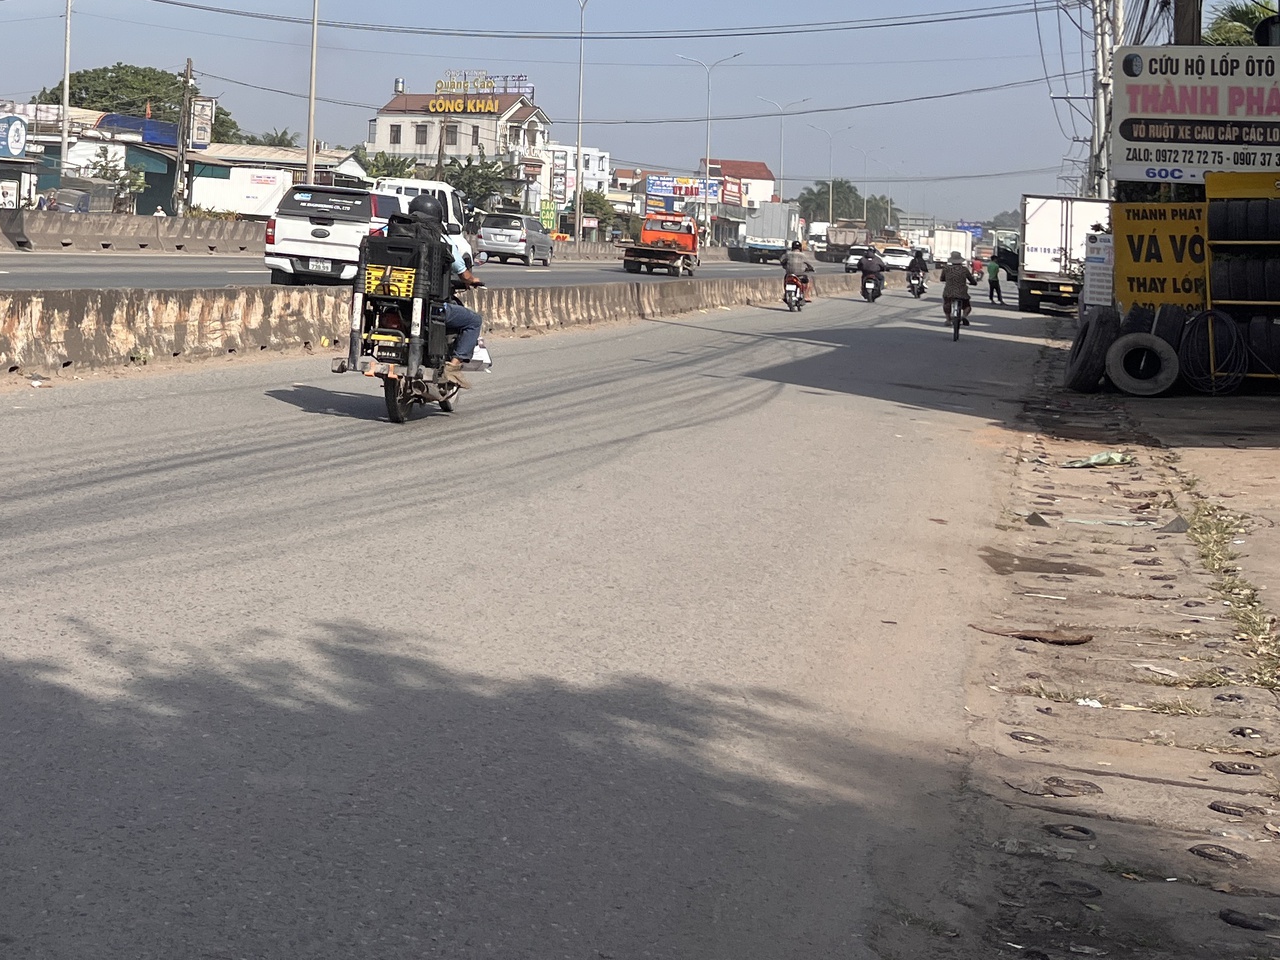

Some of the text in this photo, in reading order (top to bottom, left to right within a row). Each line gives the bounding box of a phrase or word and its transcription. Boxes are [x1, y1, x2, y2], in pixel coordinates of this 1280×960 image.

[1148, 52, 1275, 80] CỨU HỘ LỐP ÔTÔ
[428, 96, 464, 113] CÔNG
[1125, 78, 1219, 116] THÀNH
[1132, 121, 1146, 138] VỎ
[1148, 123, 1175, 142] RUỘT
[1178, 125, 1191, 140] XE
[1194, 126, 1215, 140] CAO
[1217, 122, 1240, 141] CẤP
[1242, 125, 1264, 142] CÁC
[1125, 148, 1153, 162] ZALO:
[1155, 149, 1179, 163] 0972
[1182, 150, 1194, 164] 72
[1197, 150, 1208, 164] 72
[1211, 151, 1223, 165] 75
[1233, 152, 1257, 166] 0907
[1260, 152, 1272, 166] 37
[1145, 168, 1184, 179] 60C
[541, 201, 555, 210] BAO
[541, 211, 555, 220] CAO
[542, 220, 553, 230] SU
[1126, 226, 1205, 263] VÁ VỎ
[1126, 276, 1168, 293] THAY
